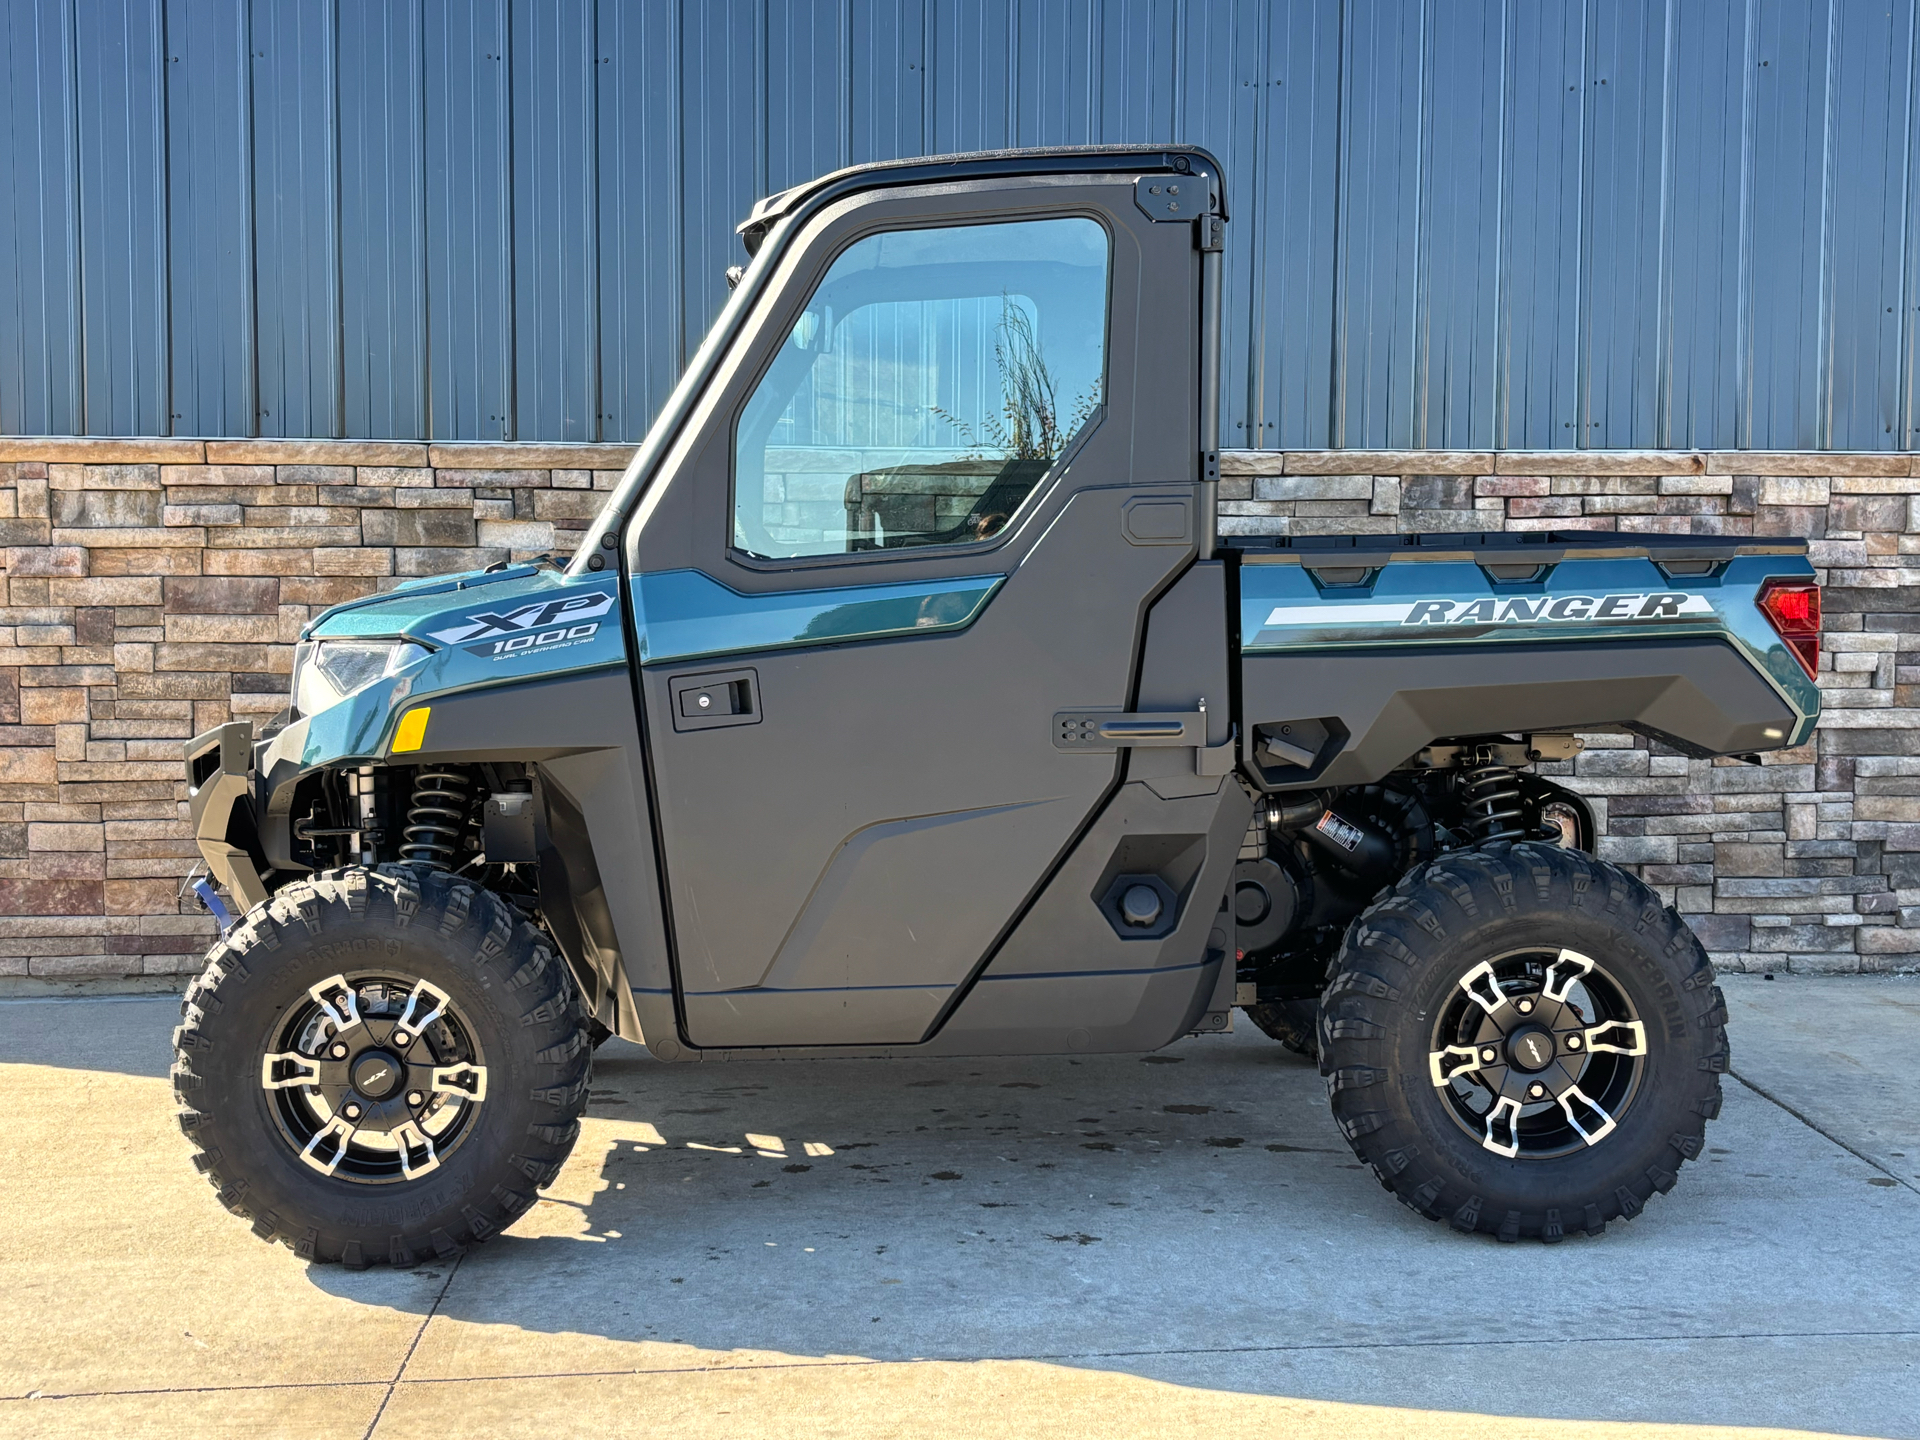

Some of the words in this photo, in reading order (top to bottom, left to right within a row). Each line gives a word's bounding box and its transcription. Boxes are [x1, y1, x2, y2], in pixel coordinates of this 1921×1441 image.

[457, 592, 610, 642] XP
[1401, 593, 1689, 626] RANGER
[493, 622, 599, 654] 1000
[493, 652, 518, 661] DUAL
[521, 641, 572, 656] OVERHEAD
[574, 637, 595, 646] CAM
[306, 938, 380, 965] ARMOR
[340, 1171, 475, 1227] X-TERRAIN
